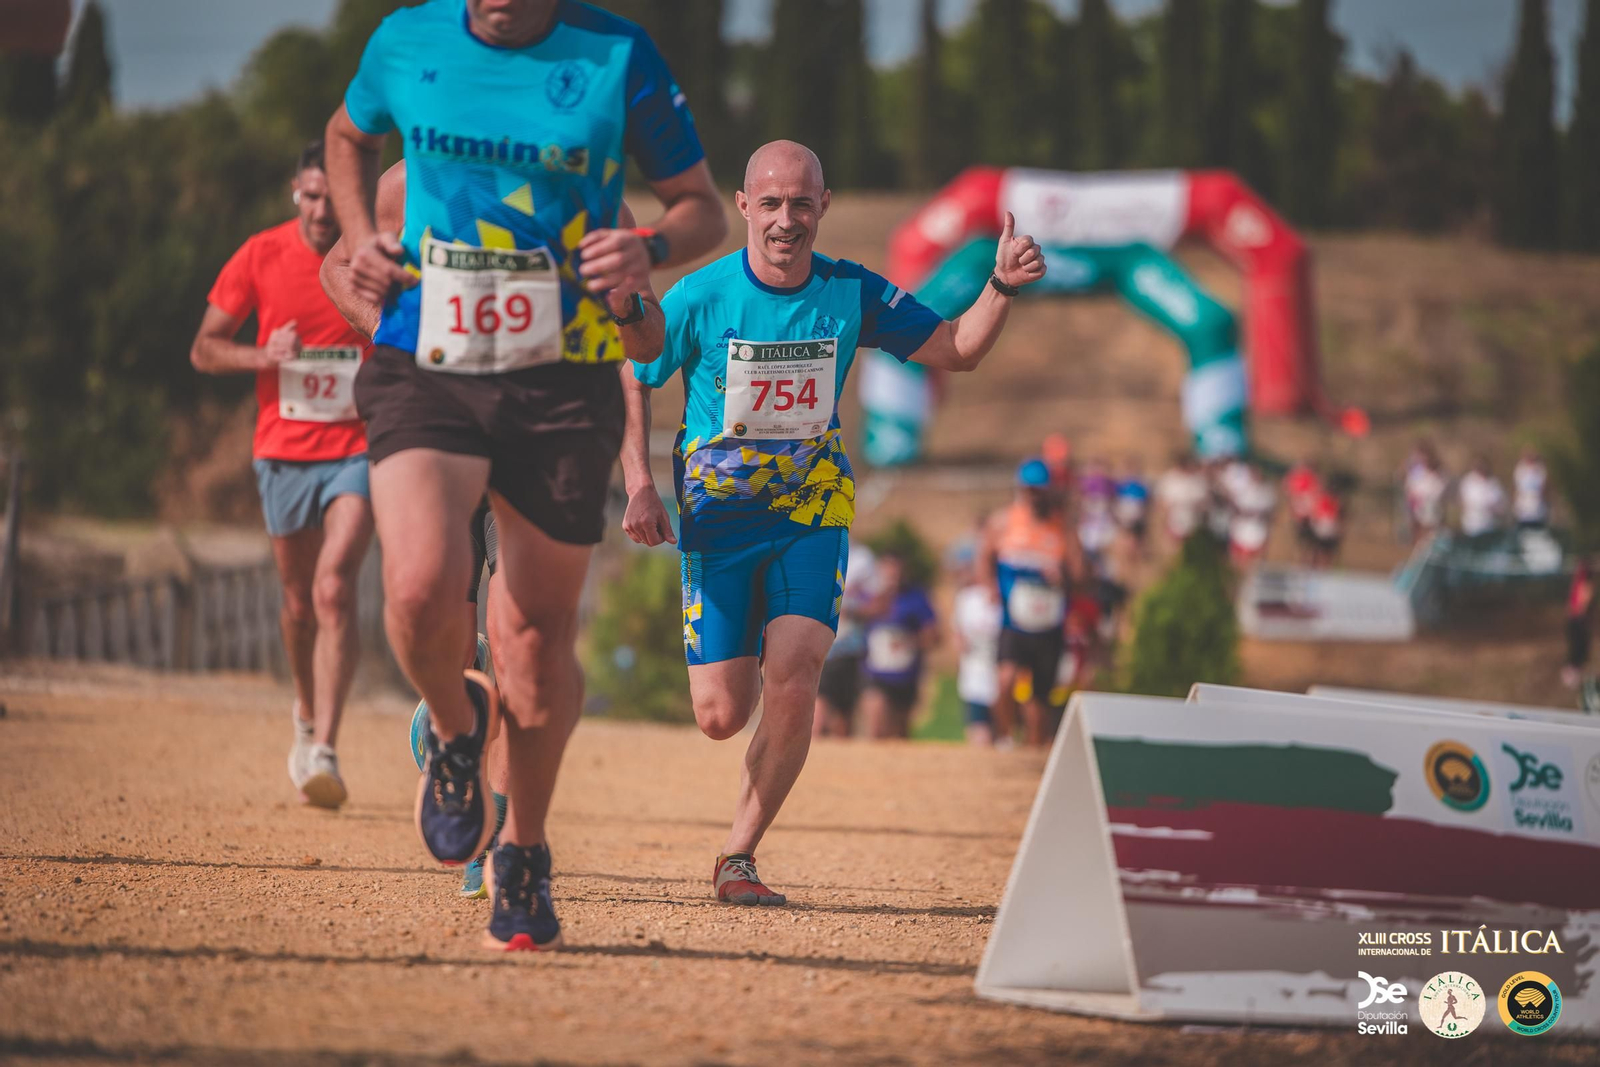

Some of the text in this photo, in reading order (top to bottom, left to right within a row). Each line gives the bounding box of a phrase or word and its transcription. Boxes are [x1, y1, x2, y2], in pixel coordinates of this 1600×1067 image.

[448, 292, 533, 335] 169
[761, 345, 811, 359] ITÁLICA
[302, 373, 338, 400] 92
[750, 378, 818, 412] 754
[1514, 808, 1573, 833] Sevilla
